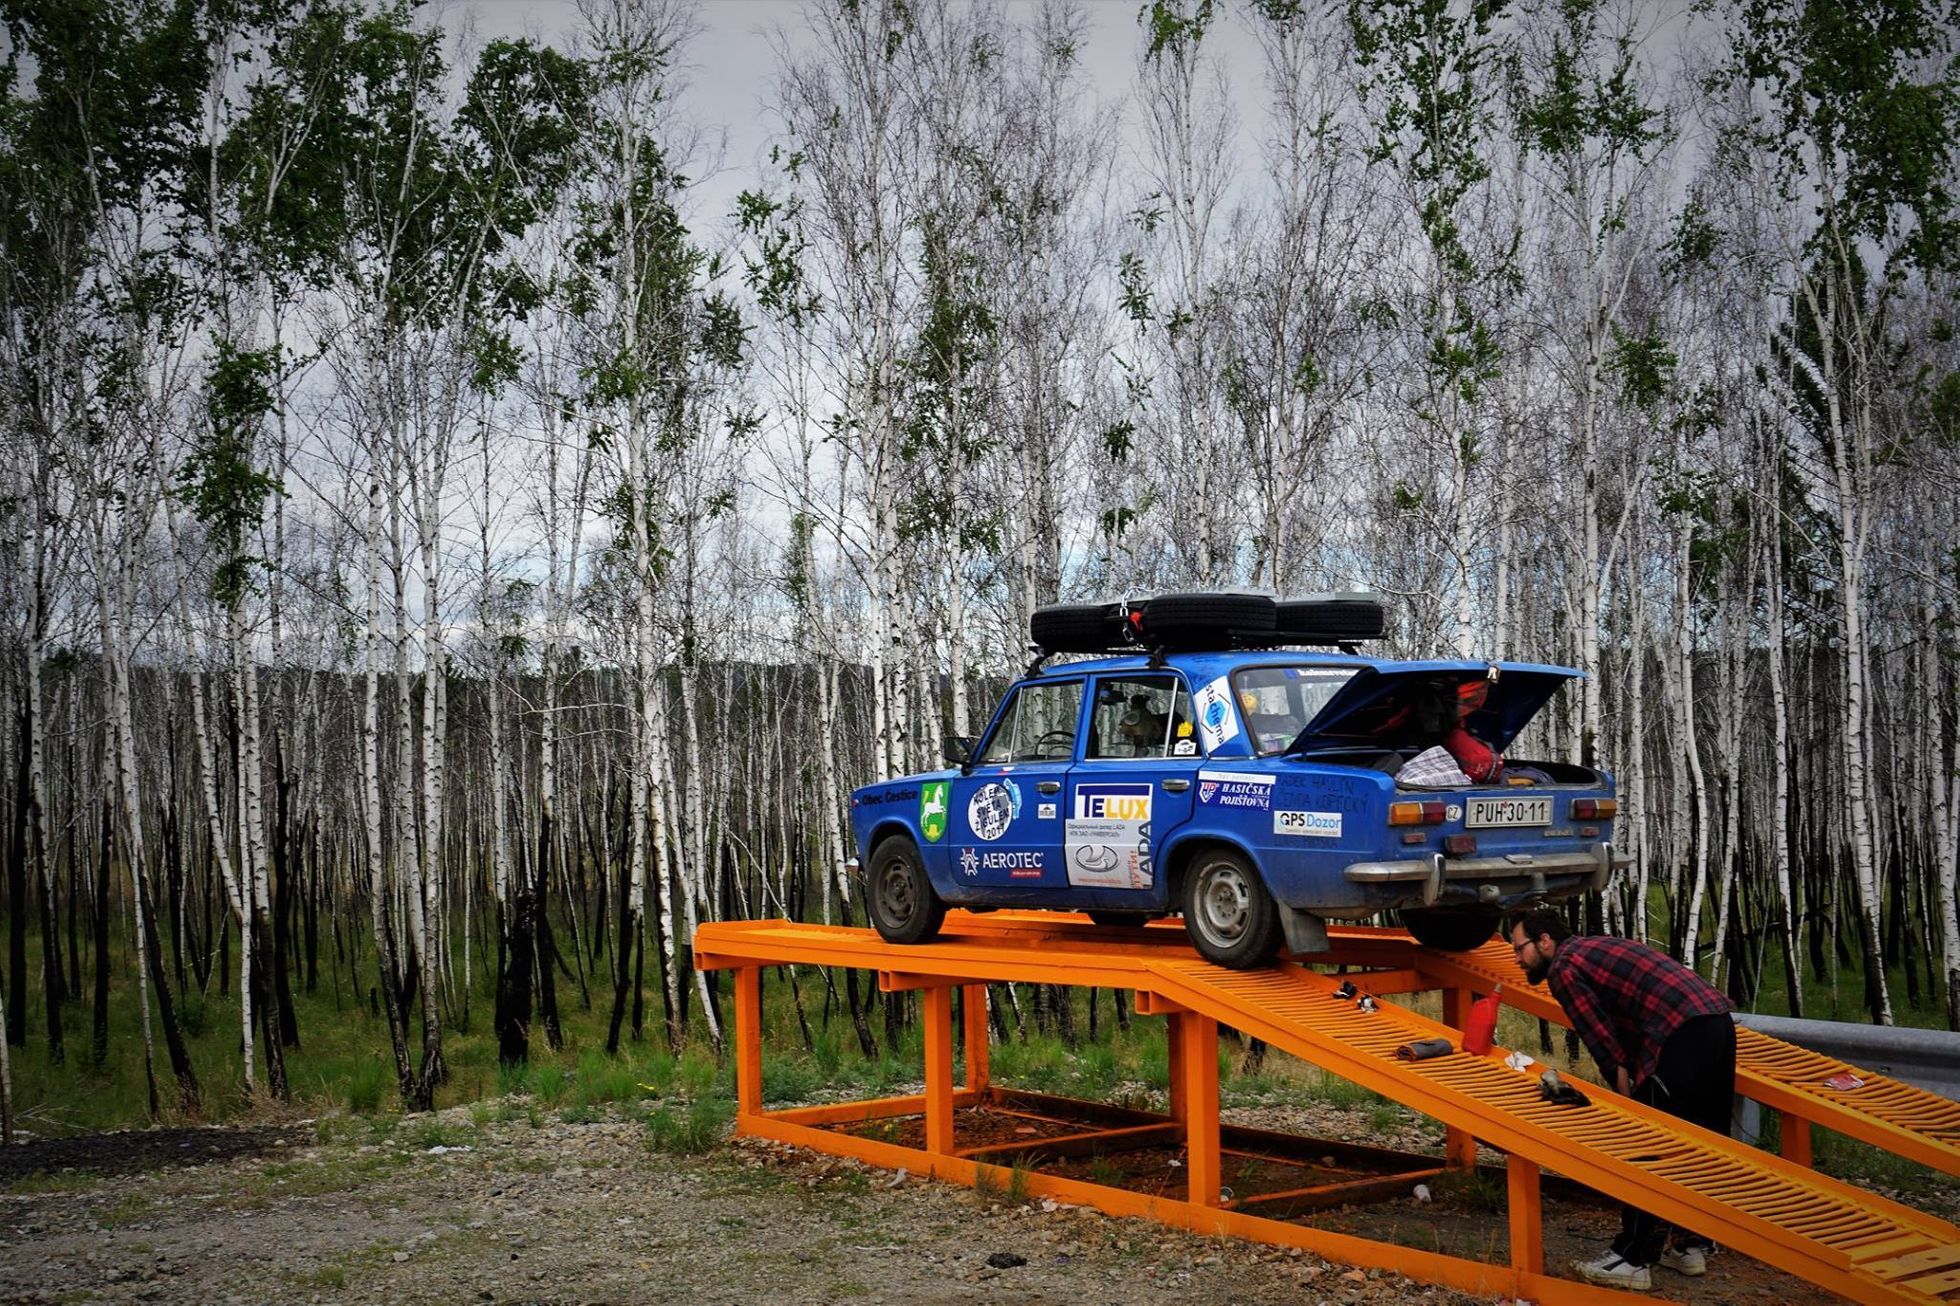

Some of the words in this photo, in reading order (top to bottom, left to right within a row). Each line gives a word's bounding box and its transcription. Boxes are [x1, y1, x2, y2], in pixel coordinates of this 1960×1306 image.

[1205, 684, 1225, 744] stachema
[974, 785, 1001, 805] KOLEM
[1222, 783, 1271, 796] HASIČSKÁ
[1078, 785, 1150, 821] TELUX
[1448, 807, 1458, 819] CZ
[986, 822, 1005, 839] 2017
[982, 852, 1043, 868] AEROTEC
